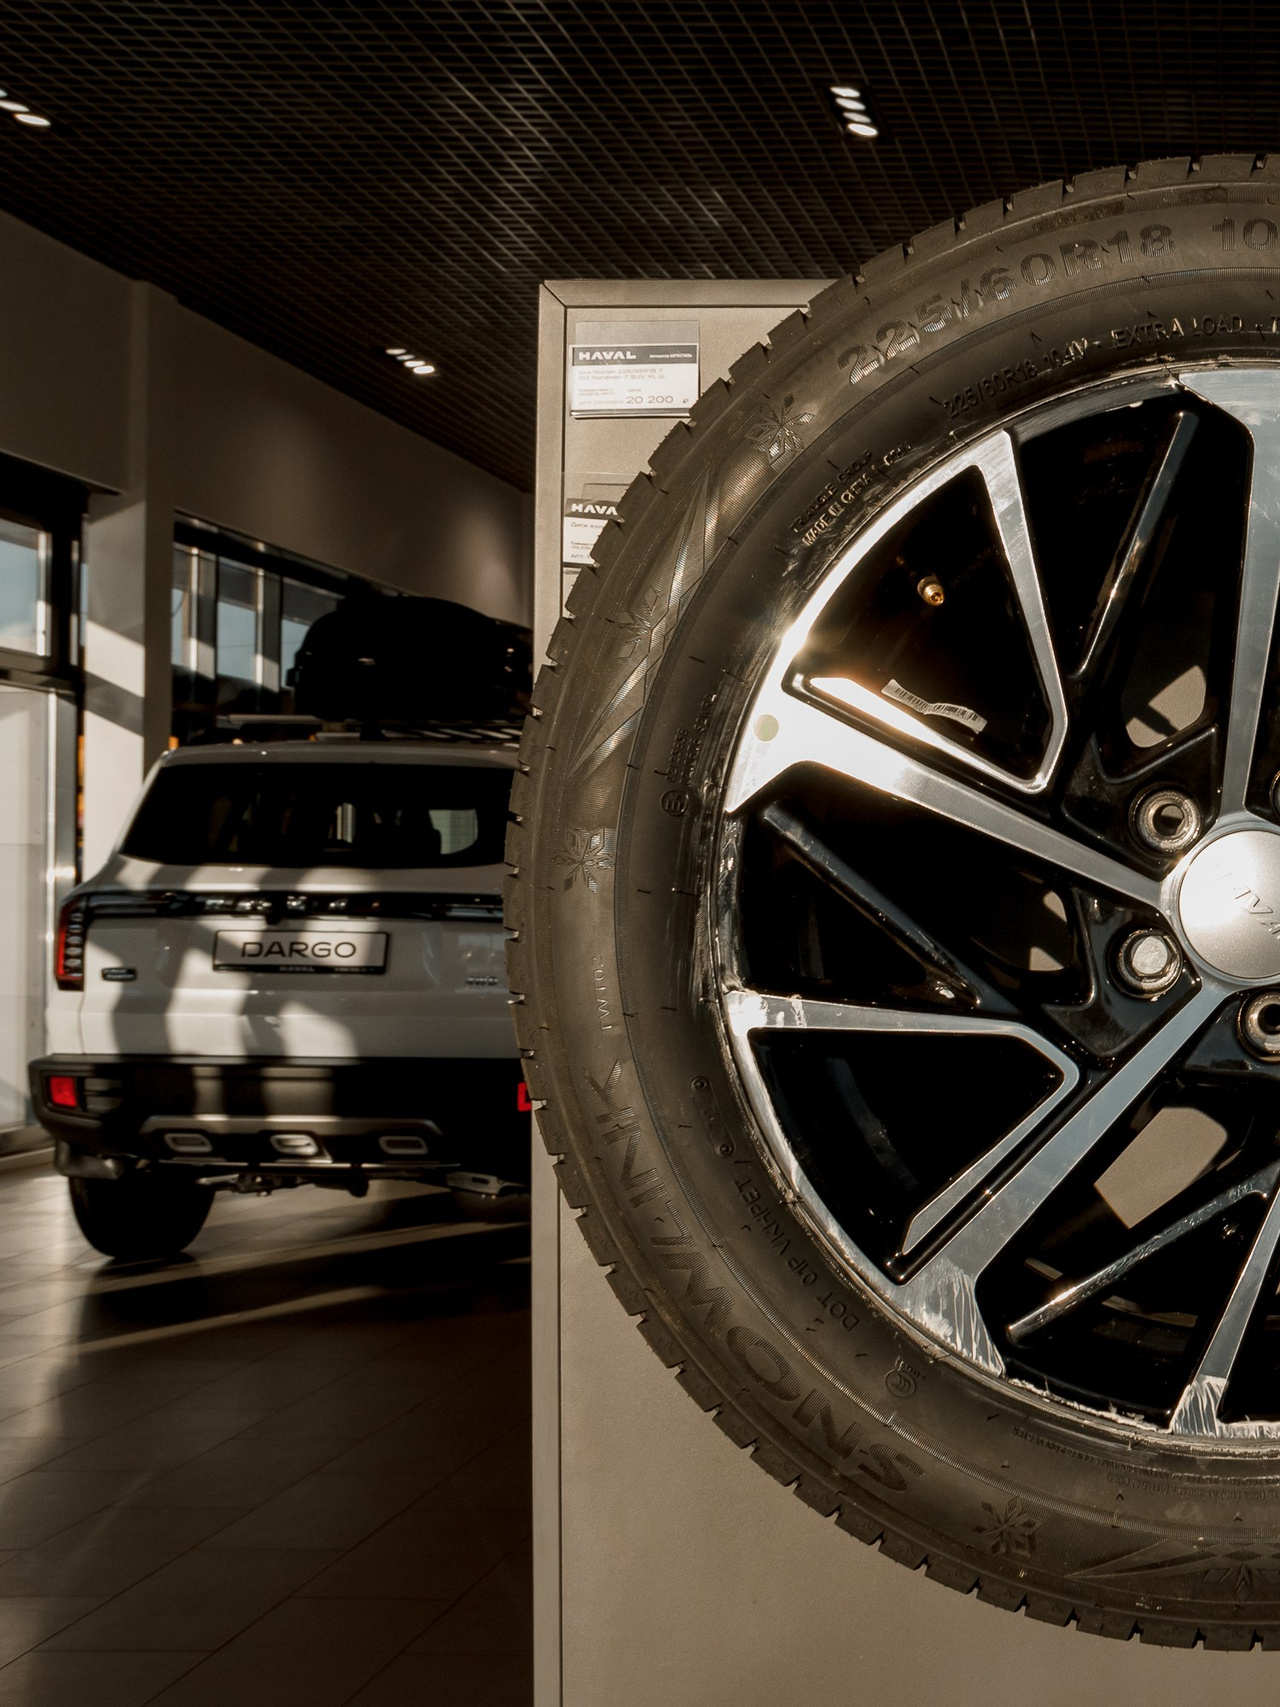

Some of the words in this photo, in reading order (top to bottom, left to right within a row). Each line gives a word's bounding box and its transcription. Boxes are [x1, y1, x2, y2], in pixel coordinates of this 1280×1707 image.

[837, 223, 1176, 386] 225/60R18
[578, 351, 637, 361] HAVAL
[941, 356, 1038, 420] 225/60R18
[1110, 316, 1184, 350] EXTRA
[1191, 312, 1243, 337] LOAD
[626, 396, 644, 404] 20
[647, 396, 674, 404] 200
[835, 447, 874, 485] GROUP
[571, 503, 619, 516] HAVA
[801, 512, 833, 547] MADE
[838, 471, 874, 506] CHINA
[241, 941, 356, 958] DARGO
[582, 1058, 926, 1493] SNOWLINK
[787, 1259, 818, 1287] 01P
[816, 1291, 860, 1332] DOT
[1105, 1472, 1130, 1487] COLD
